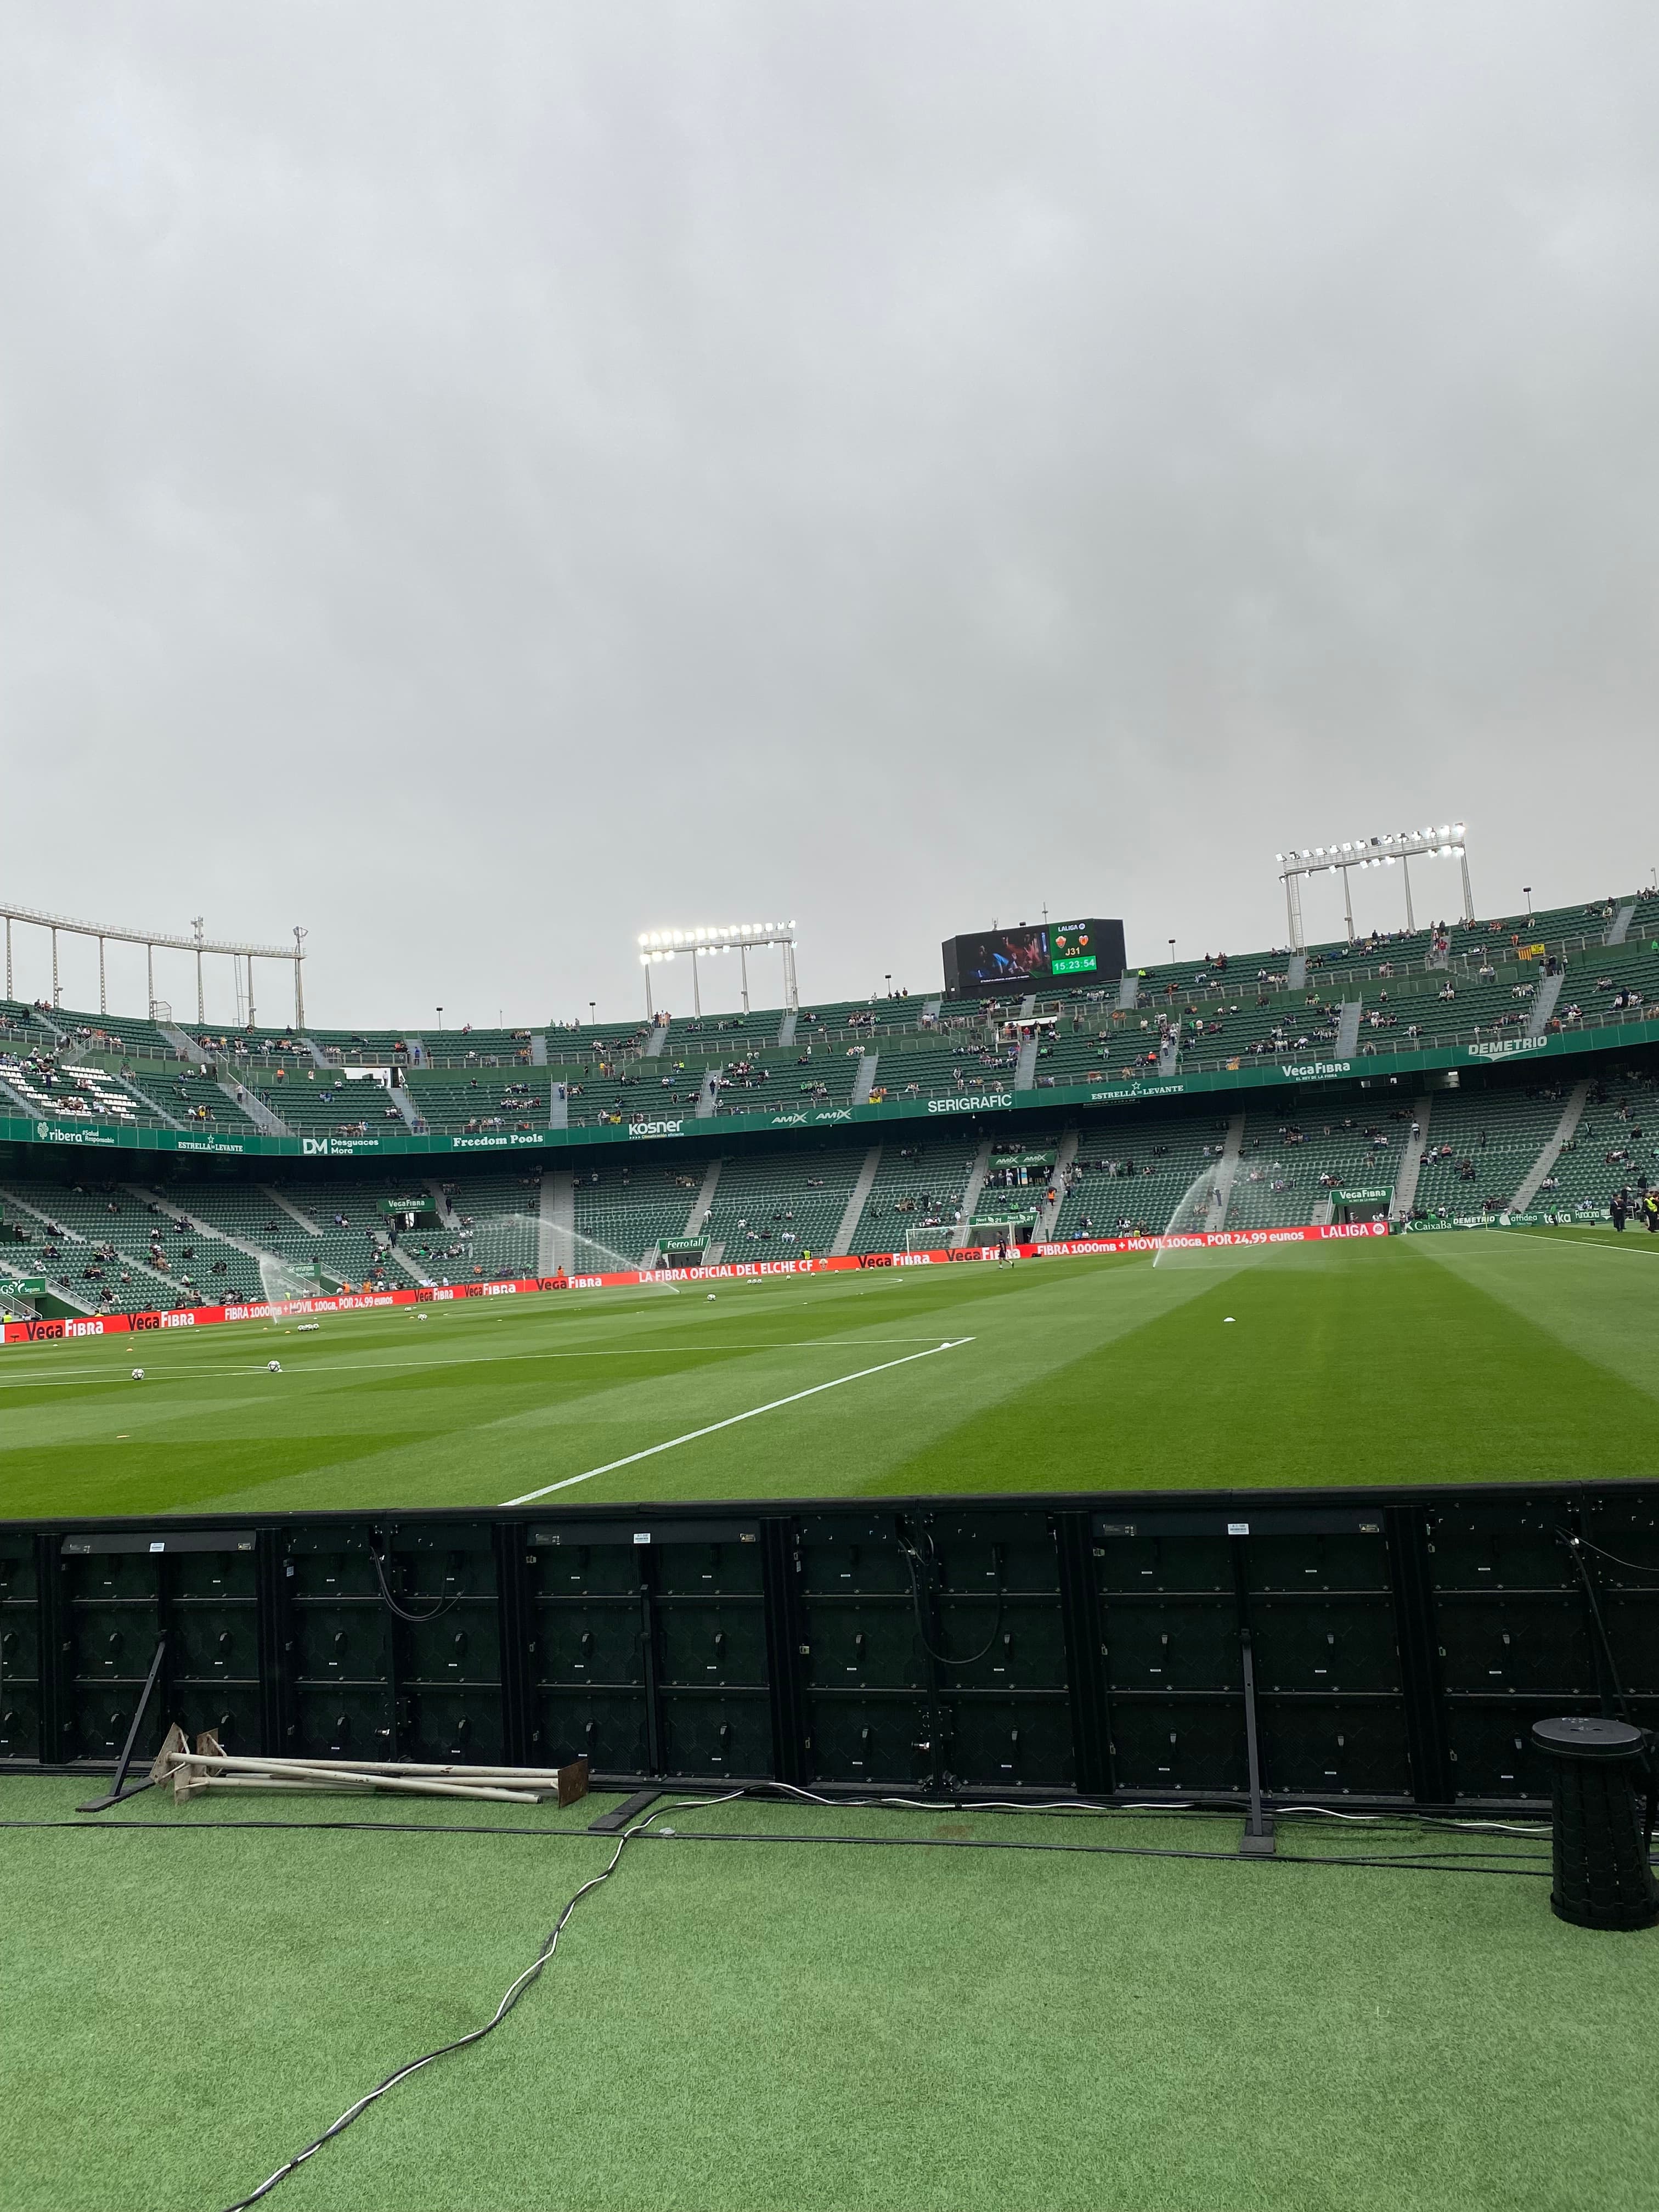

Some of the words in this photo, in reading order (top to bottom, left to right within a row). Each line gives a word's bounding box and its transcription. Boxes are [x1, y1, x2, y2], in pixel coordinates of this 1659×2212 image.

[1065, 947, 1080, 956] J31
[1054, 958, 1094, 970] 15:23:54
[1468, 1036, 1547, 1055] DEMETRIO
[1091, 1090, 1137, 1100] ESTRELLA
[1143, 1085, 1184, 1095] LEVANTE
[928, 1094, 1012, 1113] SERIGRAFIC
[771, 1111, 809, 1126] AMIX
[815, 1107, 854, 1122] AMIX
[49, 1129, 82, 1142] ribera
[331, 1138, 379, 1147] Desguaces
[453, 1136, 507, 1147] Freedom
[510, 1133, 544, 1144] Pools
[178, 1142, 211, 1150] ESTRELLA
[303, 1138, 328, 1154] DM
[995, 1155, 1019, 1165] AMIX
[1023, 1153, 1048, 1163] AMIX
[1453, 1216, 1496, 1224] DEMETRIO
[1321, 1224, 1369, 1238] LALIGA
[1037, 1245, 1070, 1255] FIBRA
[1128, 1237, 1165, 1250] MÓVIL
[1207, 1234, 1233, 1245] POR
[639, 1270, 653, 1283] LA
[655, 1268, 688, 1281] FIBRA
[690, 1265, 733, 1279] OFICIAL
[736, 1263, 759, 1276] DEL
[760, 1261, 796, 1274] ELCHE
[798, 1260, 813, 1271] CF
[224, 1306, 249, 1321] FIBRA
[338, 1297, 354, 1309] POR
